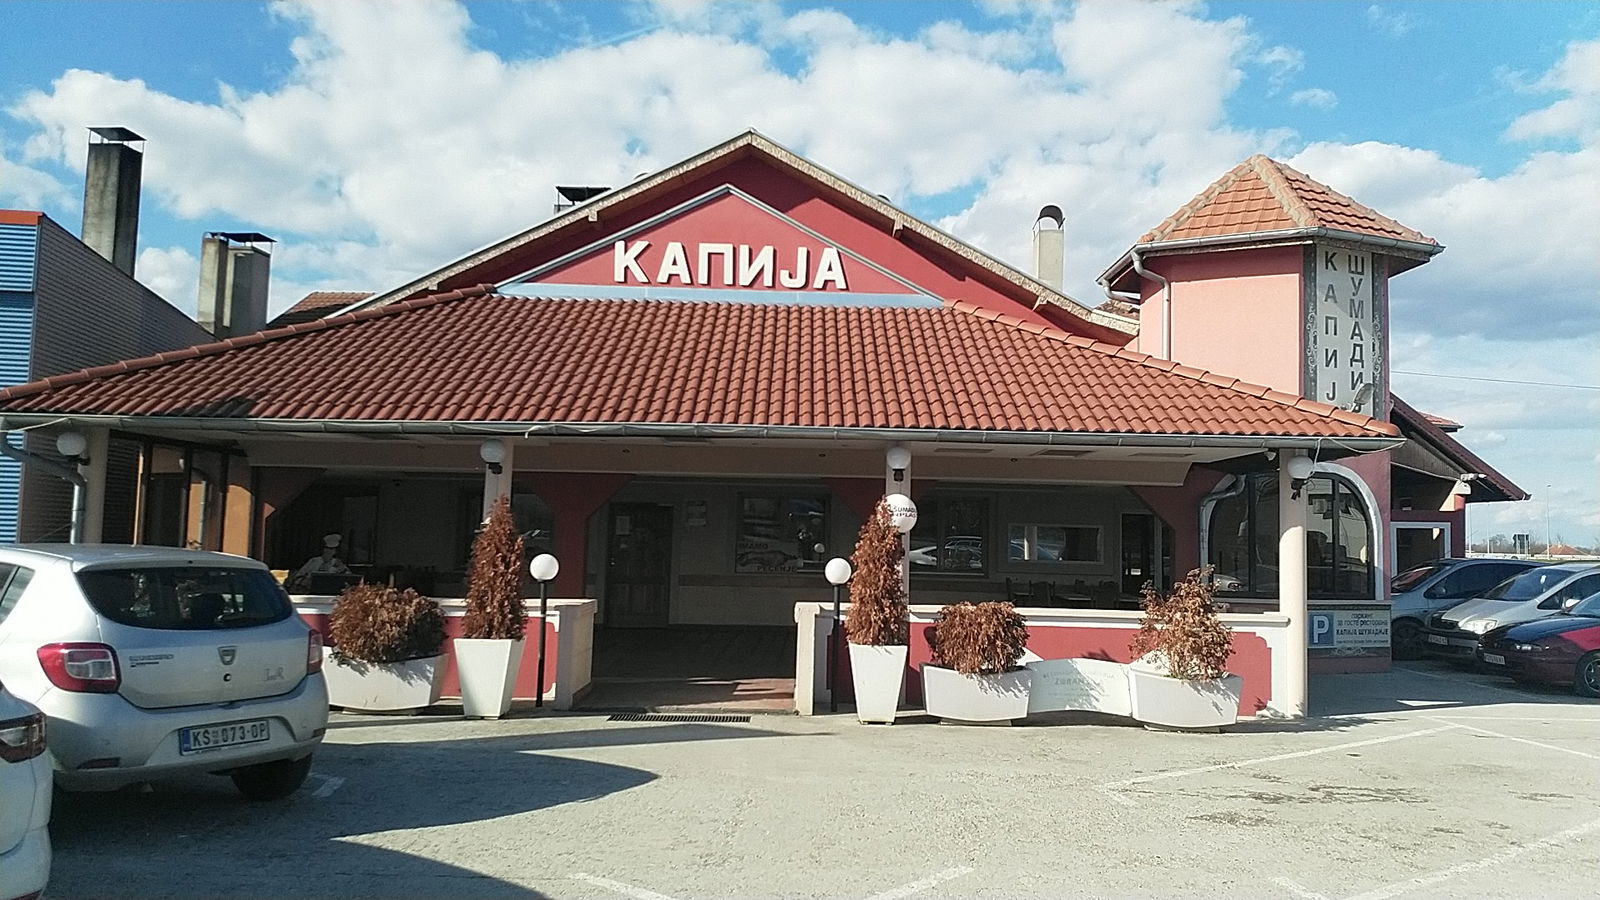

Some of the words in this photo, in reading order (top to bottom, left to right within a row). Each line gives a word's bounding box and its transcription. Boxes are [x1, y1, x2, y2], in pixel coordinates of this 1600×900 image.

[614, 240, 848, 291] КАПИЈА
[1324, 251, 1338, 401] КАПИЈ
[1347, 254, 1365, 391] ШУМАДИ
